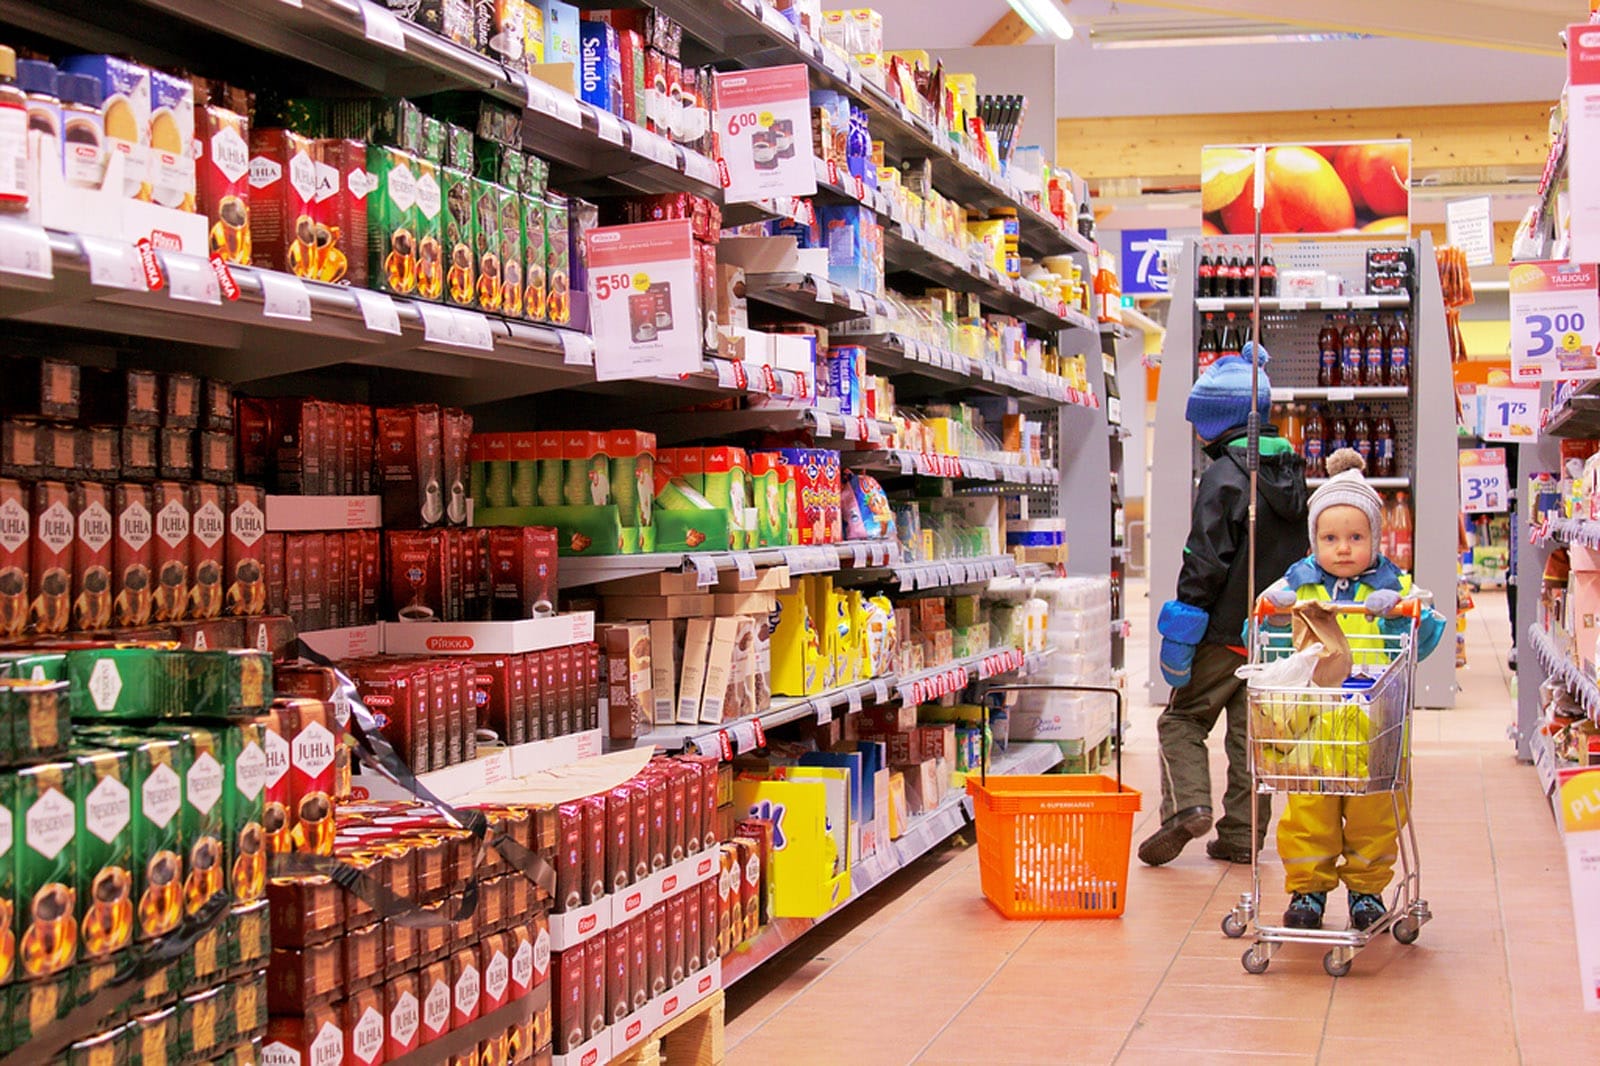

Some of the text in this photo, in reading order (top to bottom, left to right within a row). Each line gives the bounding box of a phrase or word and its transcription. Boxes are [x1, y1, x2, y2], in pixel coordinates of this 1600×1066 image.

[583, 37, 601, 92] Saludo
[217, 142, 246, 166] JUHLA
[1552, 273, 1590, 284] TARJOUS
[1568, 335, 1575, 344] 2
[1, 519, 26, 534] UHLA
[43, 520, 71, 537] JUHLA
[83, 519, 109, 536] JUHLA
[123, 519, 149, 535] JUHLA
[161, 516, 186, 533] JUHLA
[197, 517, 222, 532] JUHLA
[234, 516, 261, 532] JUHLA
[265, 752, 286, 768] HLA
[299, 742, 332, 762] JUHLA
[358, 1026, 382, 1048] JUHLA
[261, 1053, 296, 1064] JUHLA
[316, 1042, 341, 1065] JUHLA
